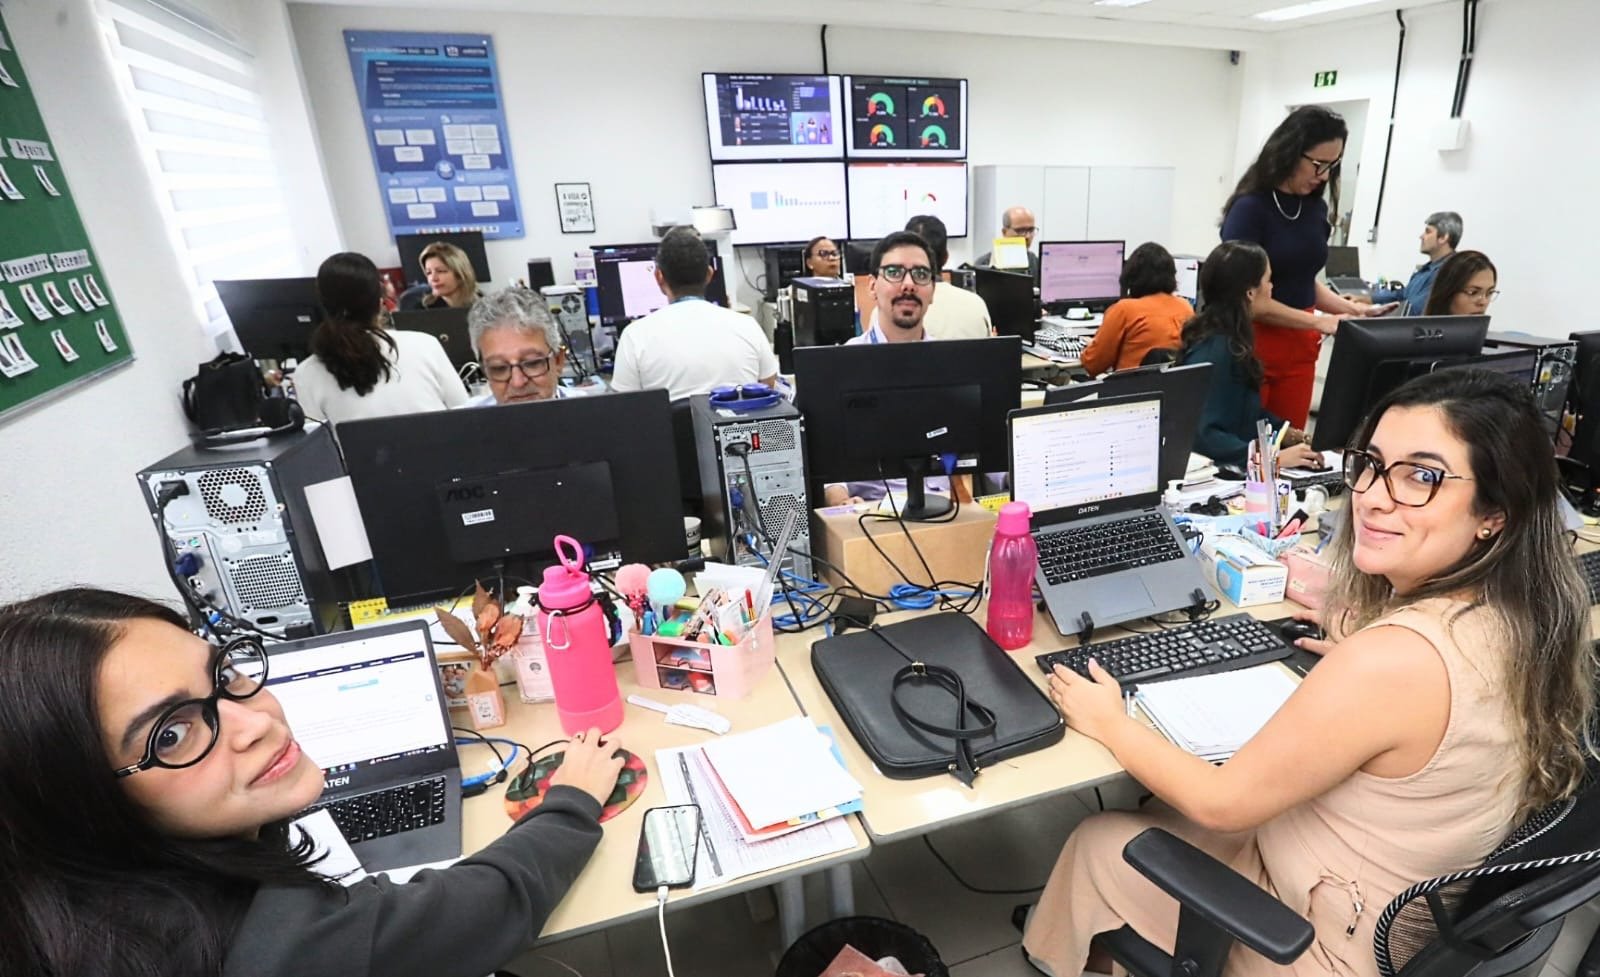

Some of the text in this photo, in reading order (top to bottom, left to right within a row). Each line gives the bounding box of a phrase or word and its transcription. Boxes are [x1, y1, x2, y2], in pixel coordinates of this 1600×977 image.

[445, 485, 484, 502] AOC
[1078, 505, 1100, 514] DATEN
[323, 775, 350, 789] ATEN
